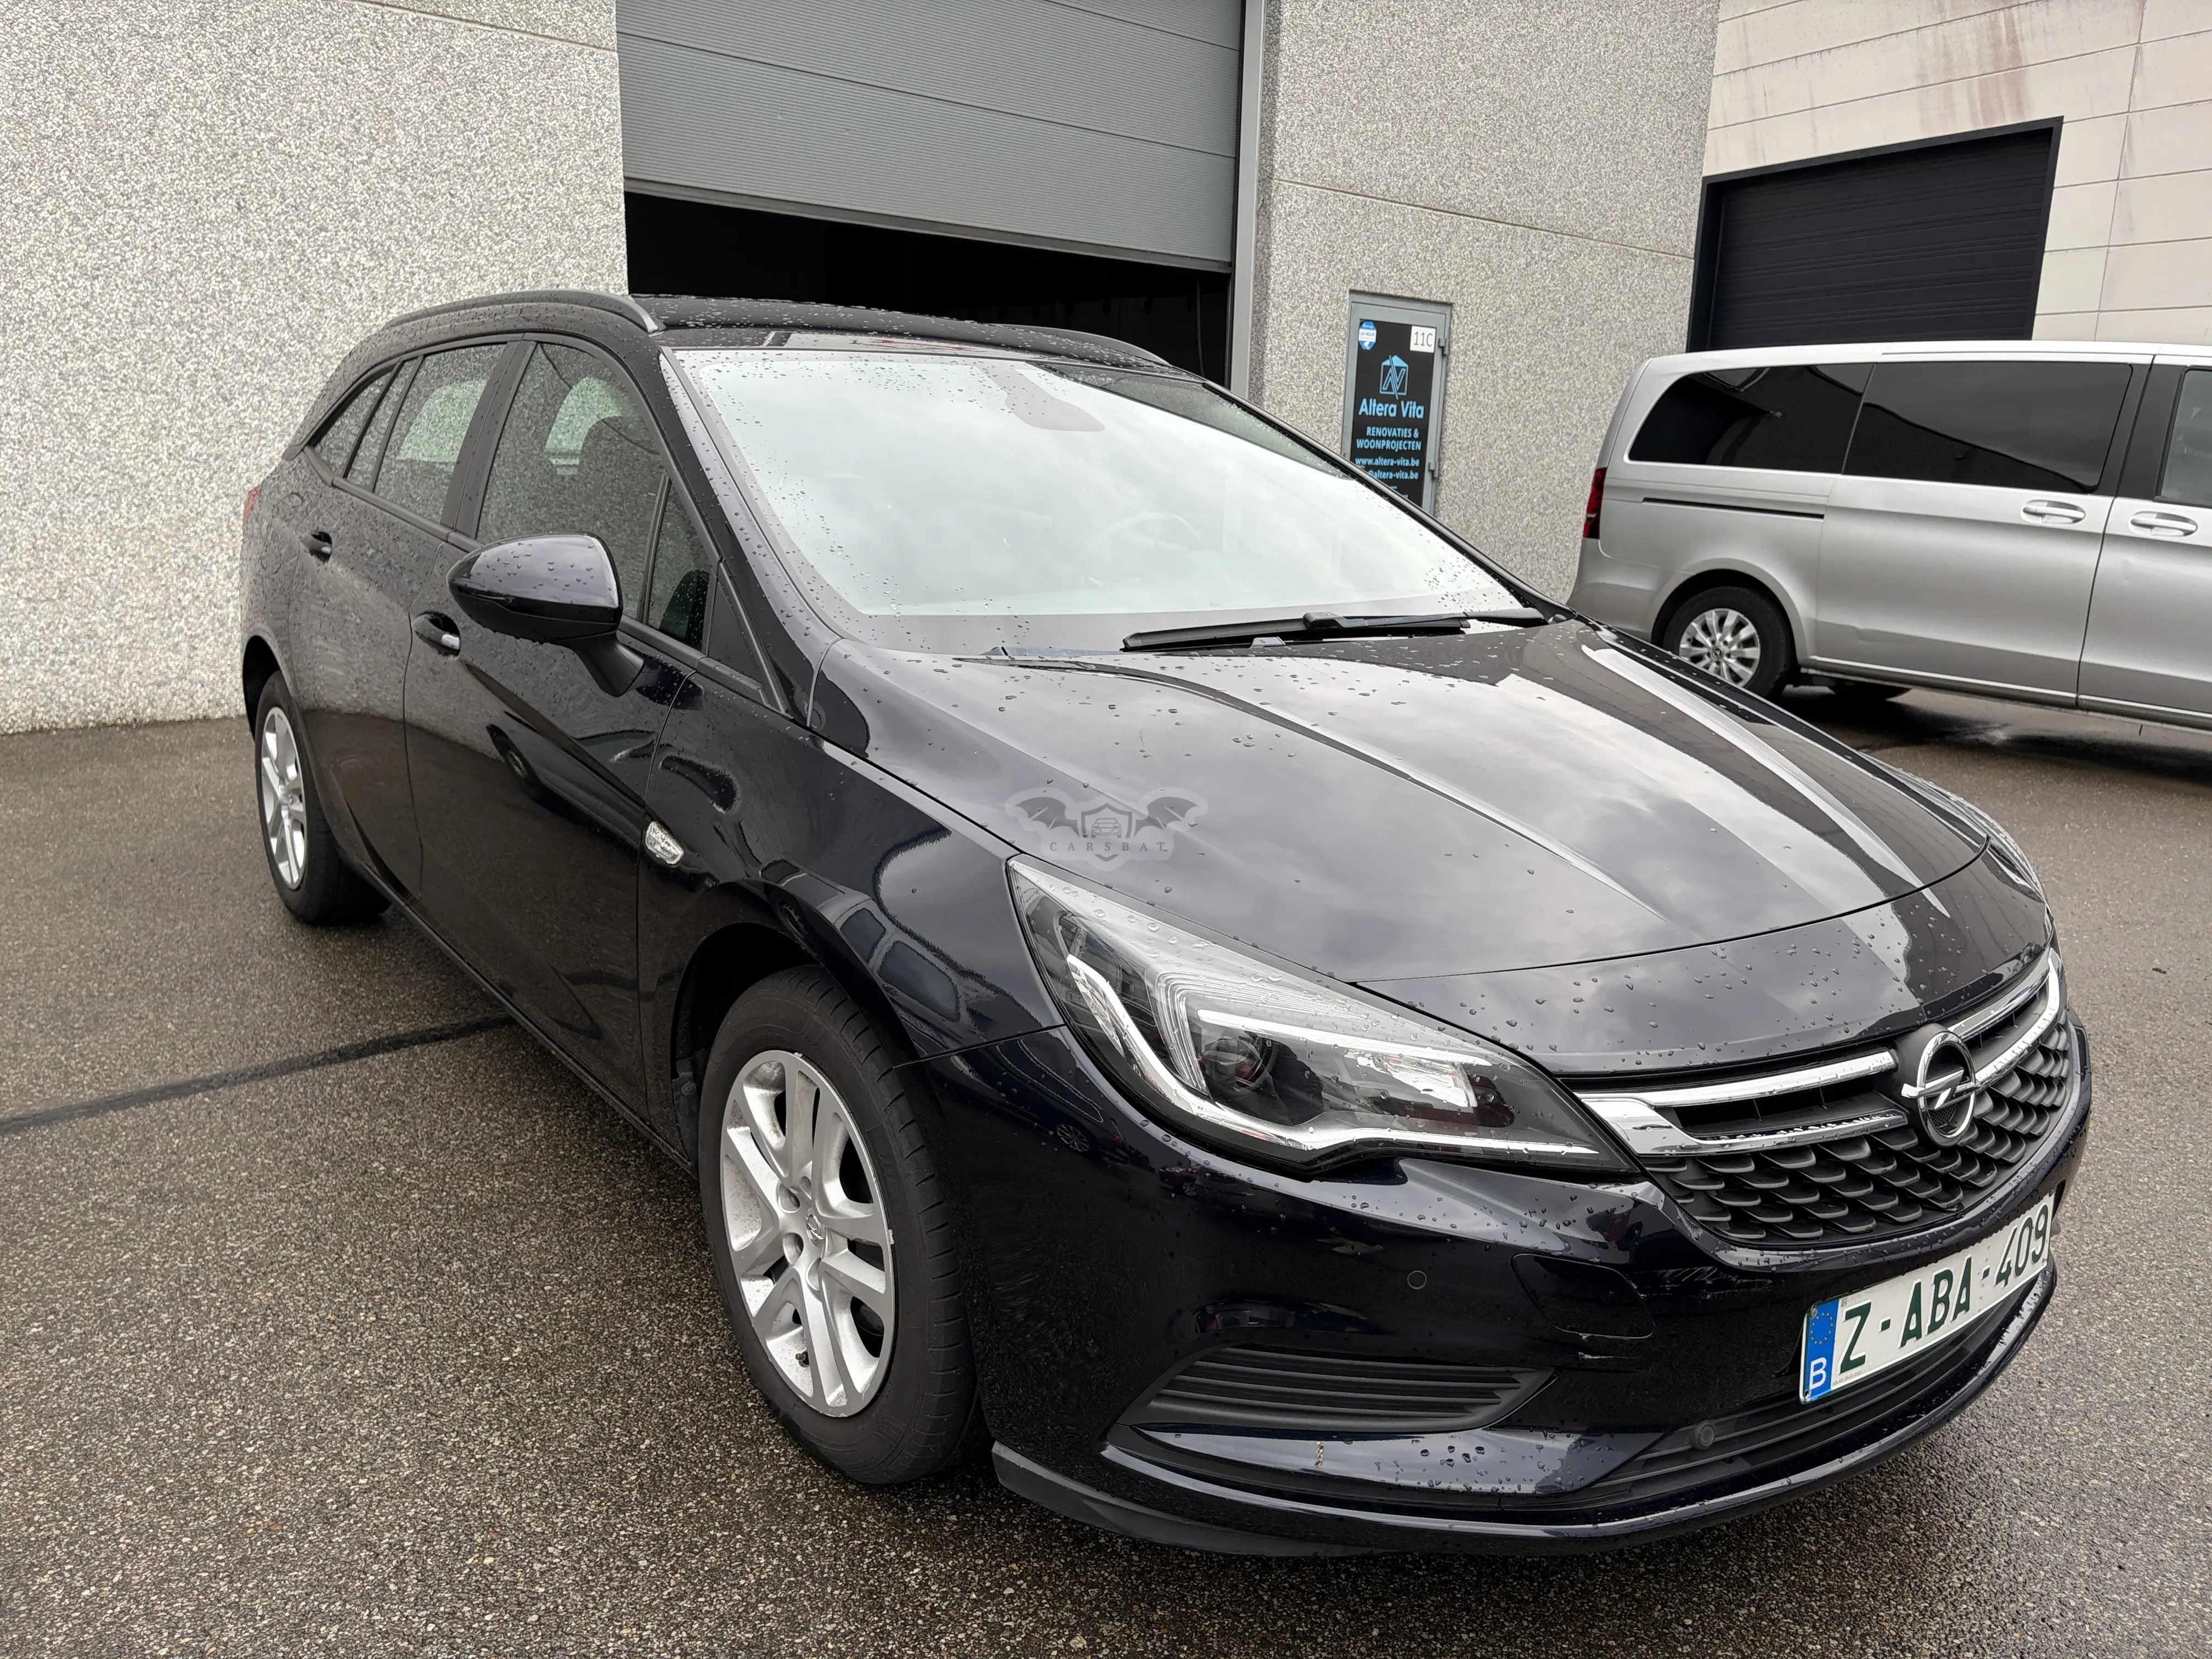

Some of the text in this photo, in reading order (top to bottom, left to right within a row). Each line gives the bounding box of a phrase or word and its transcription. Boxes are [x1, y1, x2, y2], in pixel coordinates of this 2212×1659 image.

[1413, 330, 1432, 348] 11C
[1358, 398, 1424, 419] Altera Vita
[1366, 426, 1419, 438] RENOVATIES &
[1356, 438, 1421, 453] WOONPROJECTEN
[1355, 456, 1420, 467] www.altera-vita.be
[1809, 1357, 1827, 1389] B
